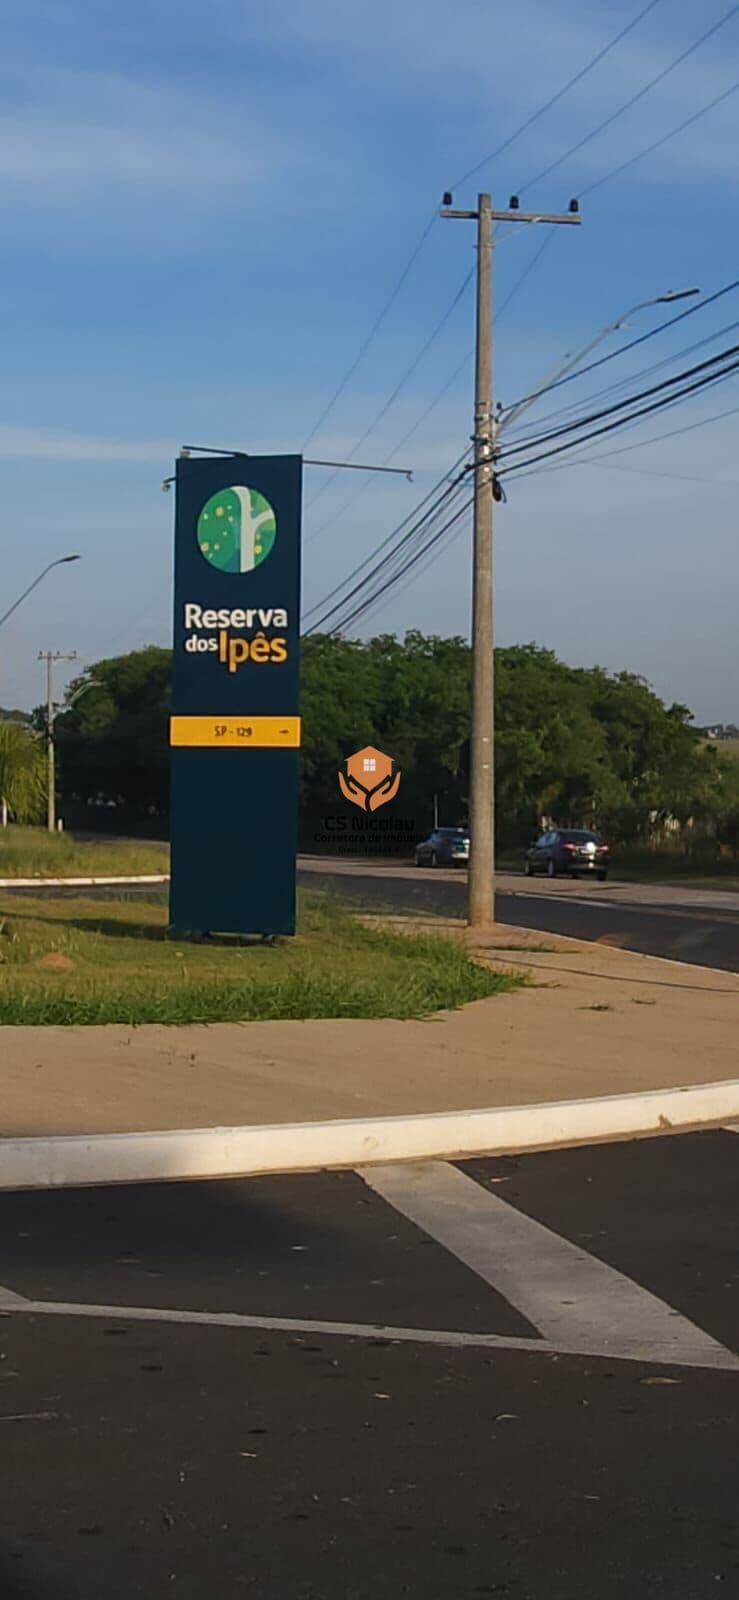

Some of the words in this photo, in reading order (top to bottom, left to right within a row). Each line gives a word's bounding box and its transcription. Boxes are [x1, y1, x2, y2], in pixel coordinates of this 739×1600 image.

[184, 603, 288, 628] Reserva
[185, 634, 218, 652] dos
[219, 630, 288, 673] Ipês
[214, 725, 227, 737] SP
